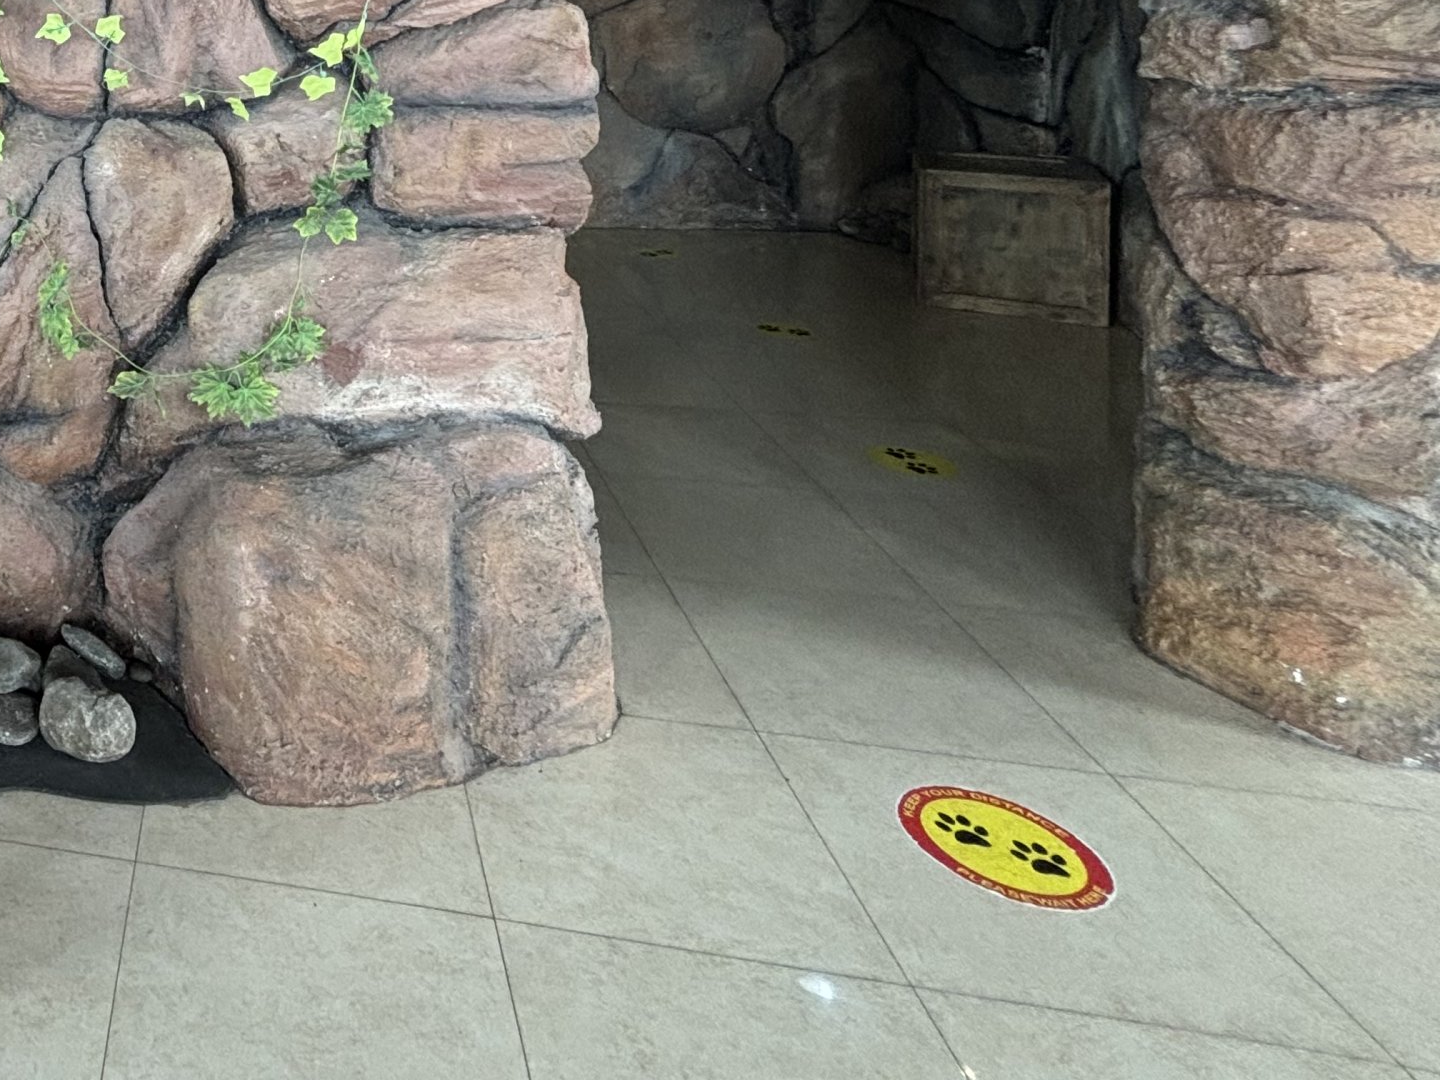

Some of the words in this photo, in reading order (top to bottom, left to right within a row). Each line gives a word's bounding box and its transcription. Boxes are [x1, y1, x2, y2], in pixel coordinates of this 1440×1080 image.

[902, 793, 920, 818] KEEP
[920, 789, 965, 798] YOUR
[968, 792, 1070, 838] DISTANCE
[1035, 896, 1079, 908] WAIT
